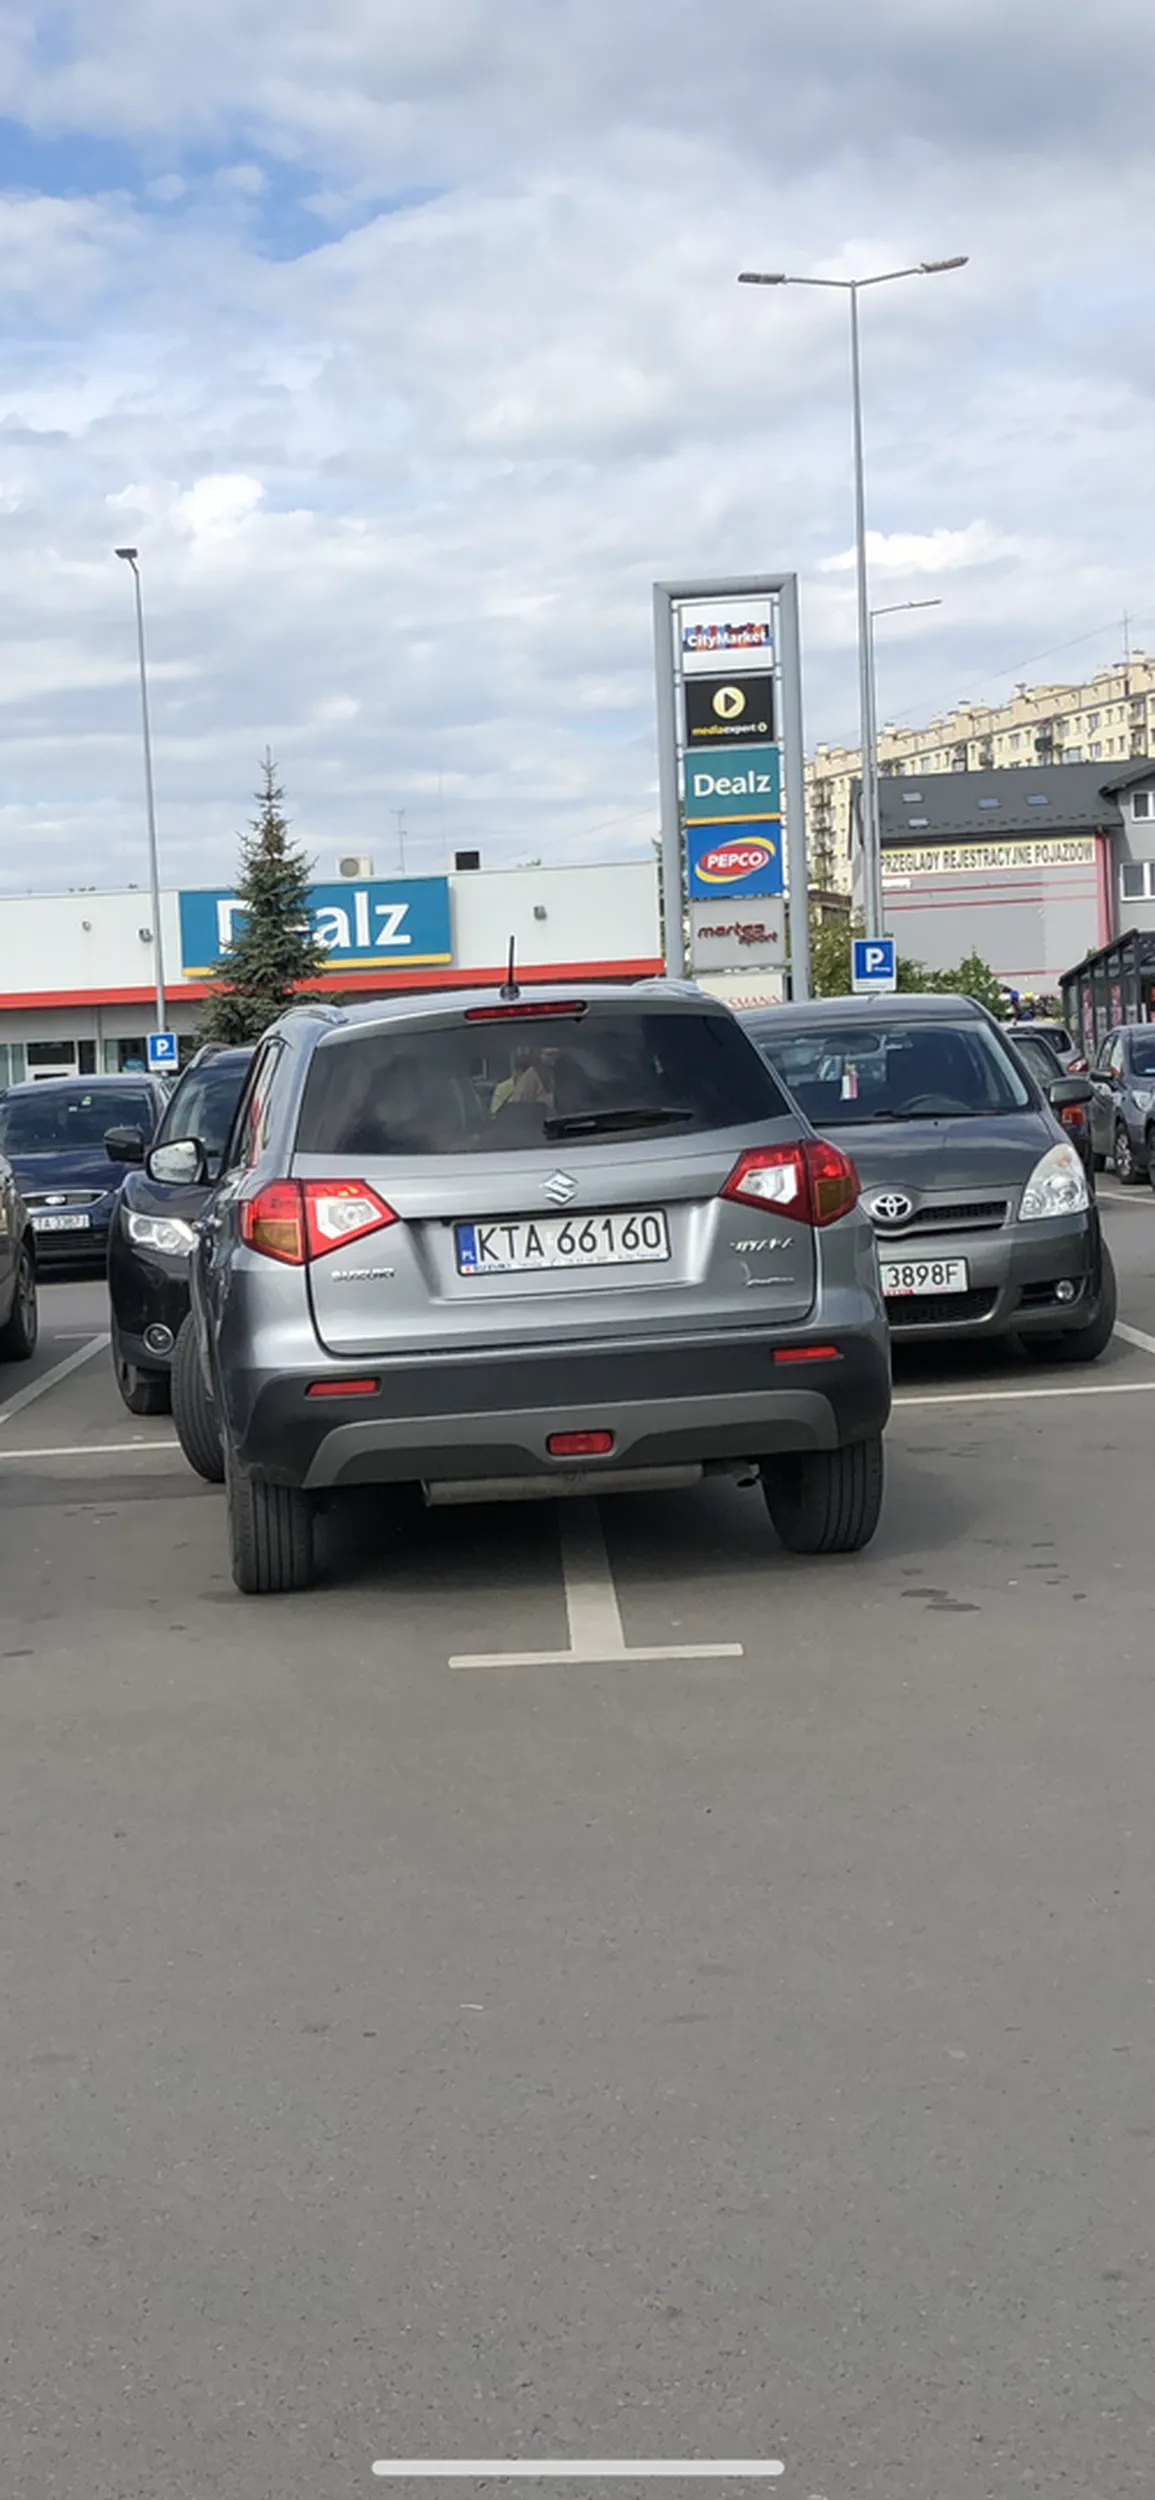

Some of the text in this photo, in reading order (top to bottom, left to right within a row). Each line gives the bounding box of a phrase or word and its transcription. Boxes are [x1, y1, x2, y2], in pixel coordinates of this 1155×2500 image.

[687, 630, 767, 649] CityMarket
[691, 723, 757, 736] mediaexpert
[693, 769, 771, 797] Dealz
[707, 852, 763, 869] PEPCO
[943, 847, 1032, 870] REJESTRACYJNE
[216, 891, 412, 955] Dalz
[865, 947, 885, 973] P
[156, 1038, 170, 1057] P
[477, 1224, 545, 1262] KTA
[557, 1215, 661, 1255] 66160
[887, 1263, 959, 1288] 3898F
